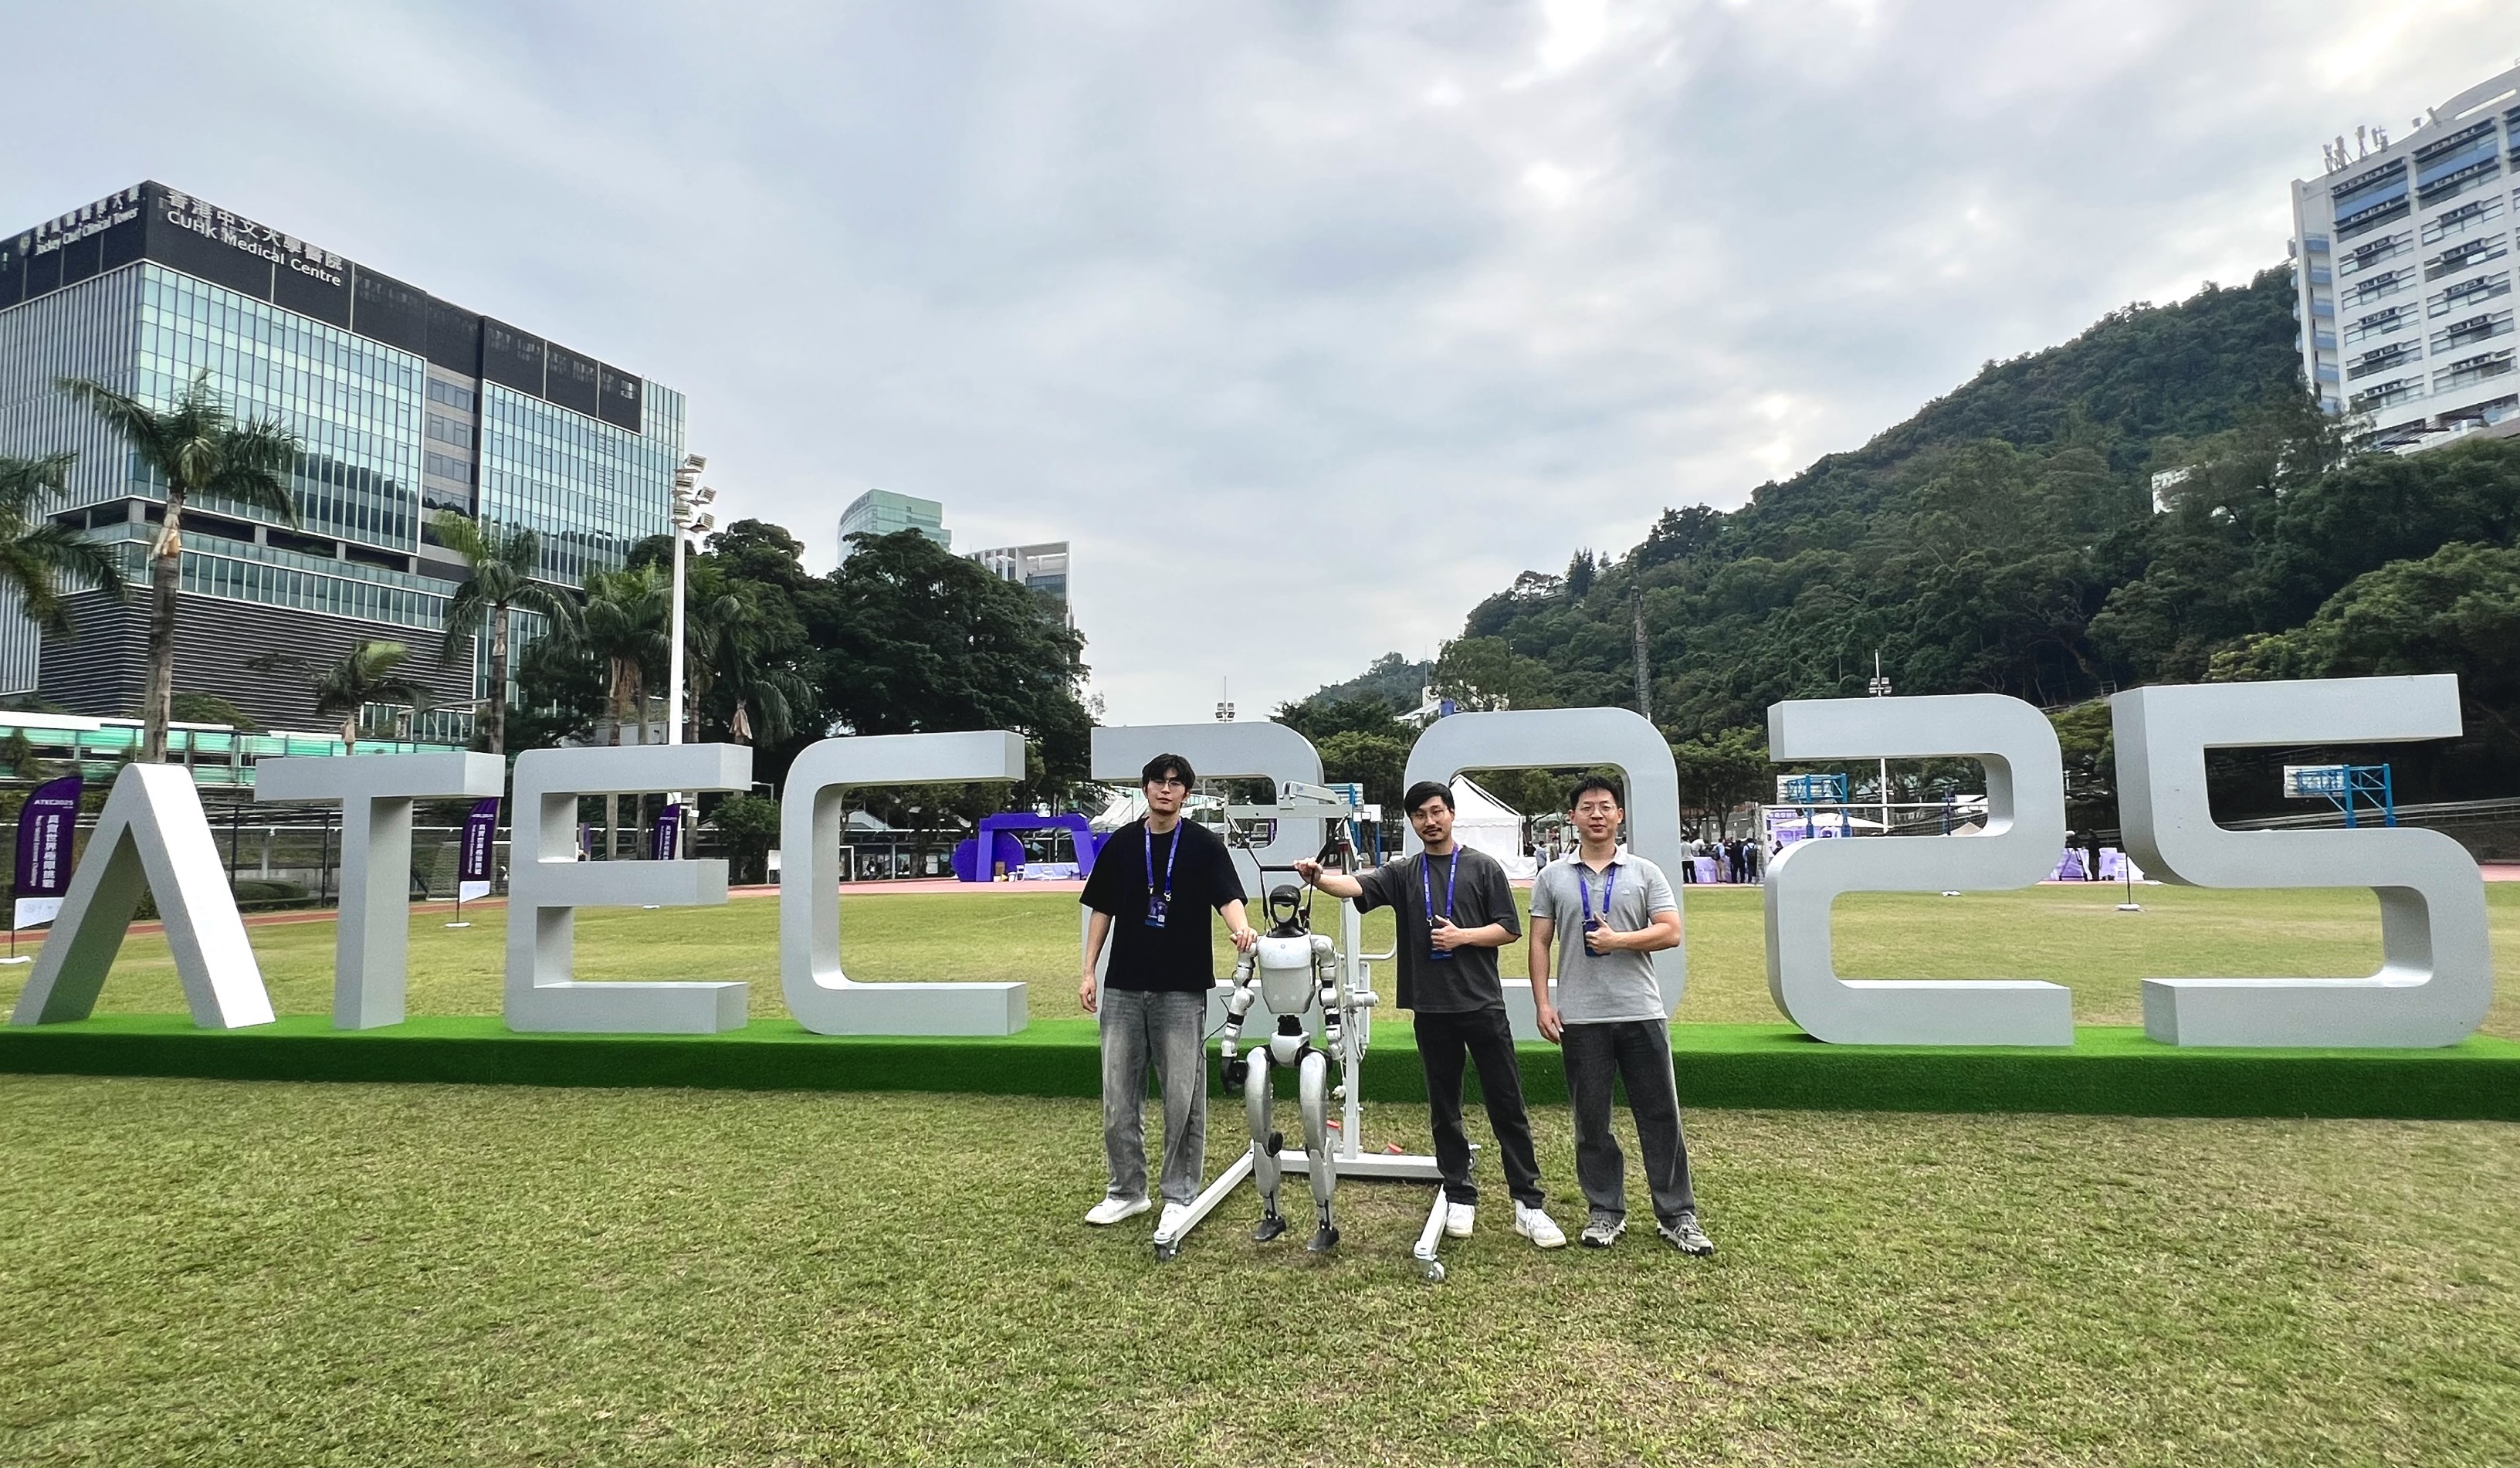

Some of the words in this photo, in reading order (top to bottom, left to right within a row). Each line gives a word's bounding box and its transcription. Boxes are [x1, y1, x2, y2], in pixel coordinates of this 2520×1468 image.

[167, 210, 218, 239] CUHK
[223, 233, 285, 265] Medical
[290, 258, 341, 286] Centre
